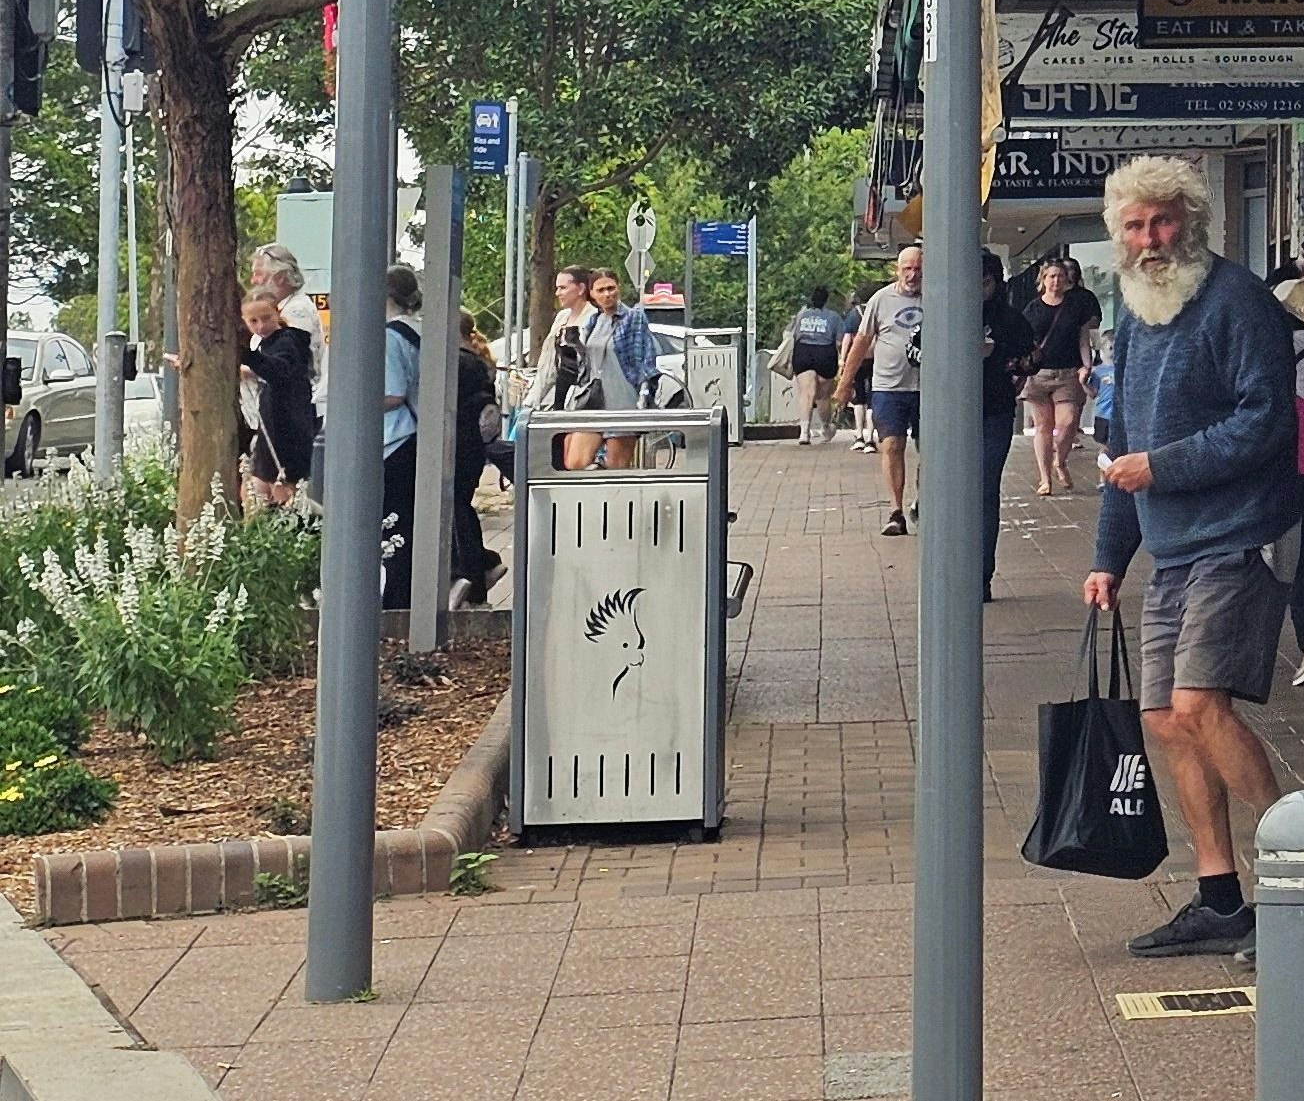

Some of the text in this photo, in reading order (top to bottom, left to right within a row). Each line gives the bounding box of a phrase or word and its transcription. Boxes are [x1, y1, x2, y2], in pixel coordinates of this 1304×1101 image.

[1093, 17, 1140, 51] Sta
[1156, 20, 1192, 35] EAT
[1209, 20, 1229, 34] IN
[1242, 20, 1256, 34] &
[1042, 54, 1294, 66] CAKES PIES ROLLS SOURDOUGH
[1185, 99, 1302, 111] TEL. 02 9589 1216
